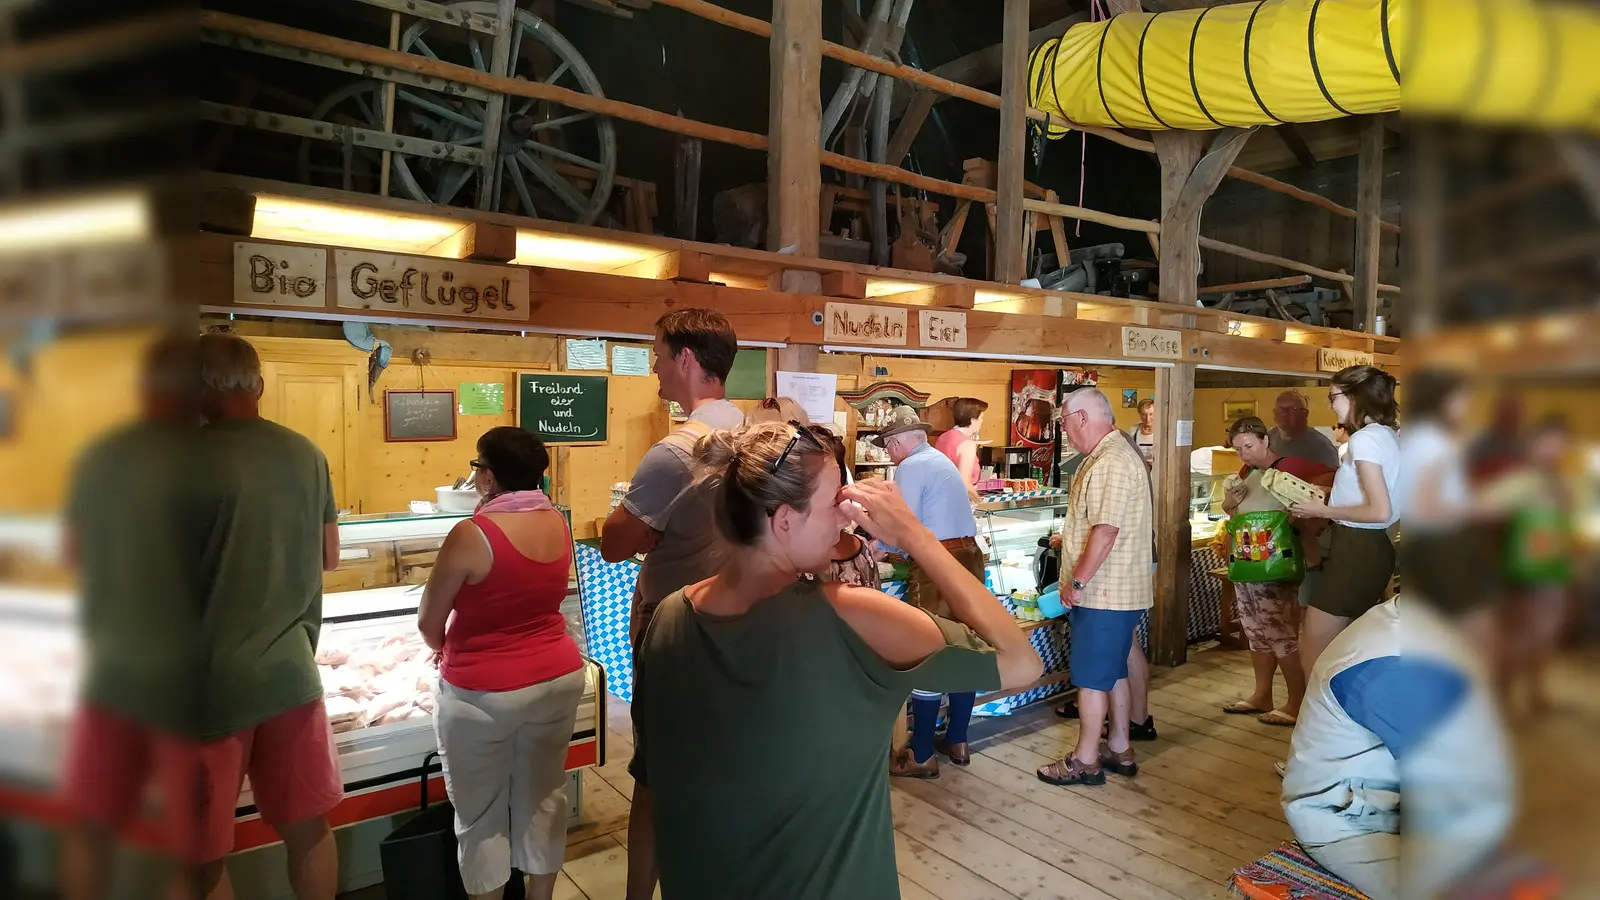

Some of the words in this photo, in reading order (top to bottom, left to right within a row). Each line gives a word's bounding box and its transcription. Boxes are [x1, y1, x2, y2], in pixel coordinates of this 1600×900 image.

[250, 254, 317, 298] Bio
[351, 261, 516, 313] Geflügel
[833, 310, 903, 339] Nudeln
[929, 315, 960, 342] Eier
[1128, 330, 1147, 351] Bio
[528, 381, 588, 395] Freiland-
[550, 395, 575, 406] eier
[552, 407, 574, 418] und
[538, 419, 581, 434] Nudeln
